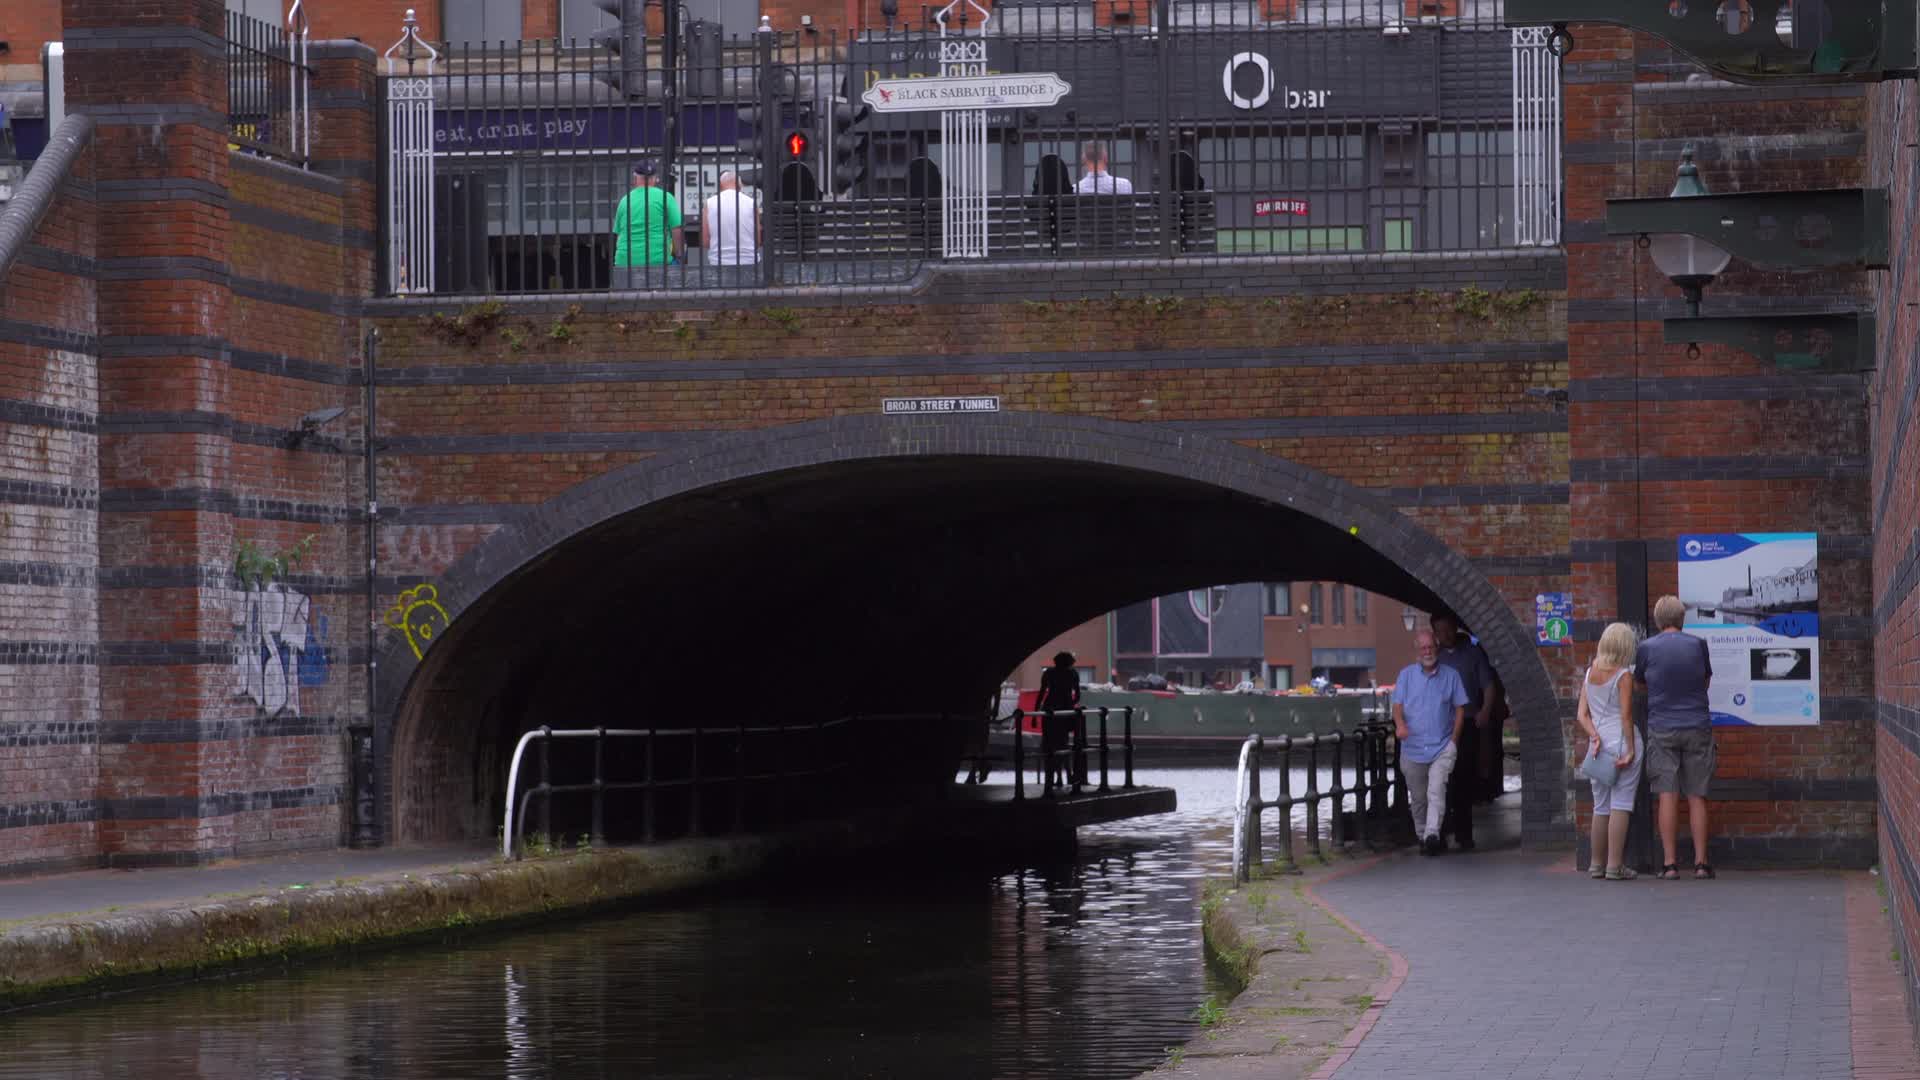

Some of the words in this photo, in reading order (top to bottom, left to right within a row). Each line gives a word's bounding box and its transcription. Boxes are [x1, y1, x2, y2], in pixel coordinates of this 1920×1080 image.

[1223, 51, 1275, 109] O
[1285, 85, 1331, 109] bar
[898, 88, 937, 100] BLACK
[940, 85, 996, 98] SABBATH
[1000, 84, 1047, 96] BRIDGE
[543, 117, 588, 138] play
[886, 401, 917, 411] BROAD
[920, 400, 956, 410] STREET
[959, 399, 996, 410] TUNNEL
